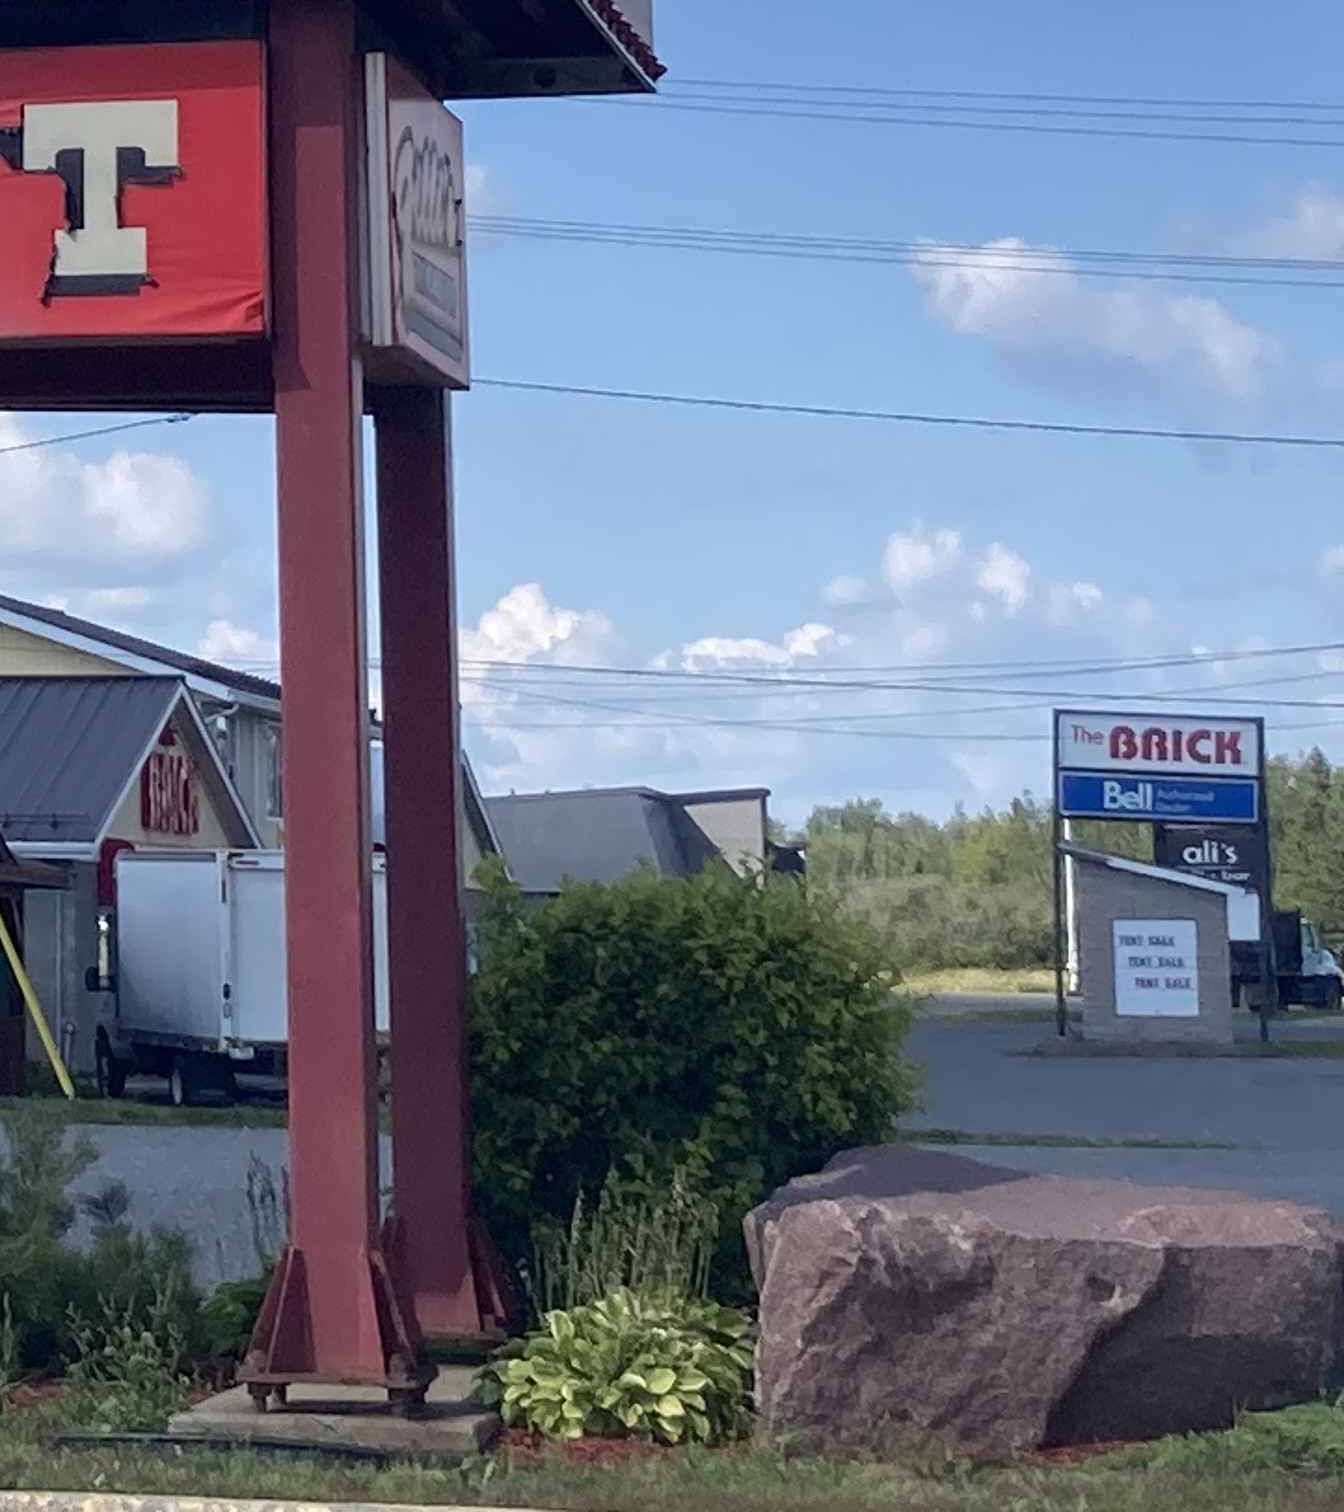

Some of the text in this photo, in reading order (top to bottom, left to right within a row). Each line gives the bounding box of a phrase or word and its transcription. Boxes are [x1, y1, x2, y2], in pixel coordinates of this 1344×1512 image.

[1070, 724, 1243, 765] The BRICK
[1103, 780, 1153, 812] Bell
